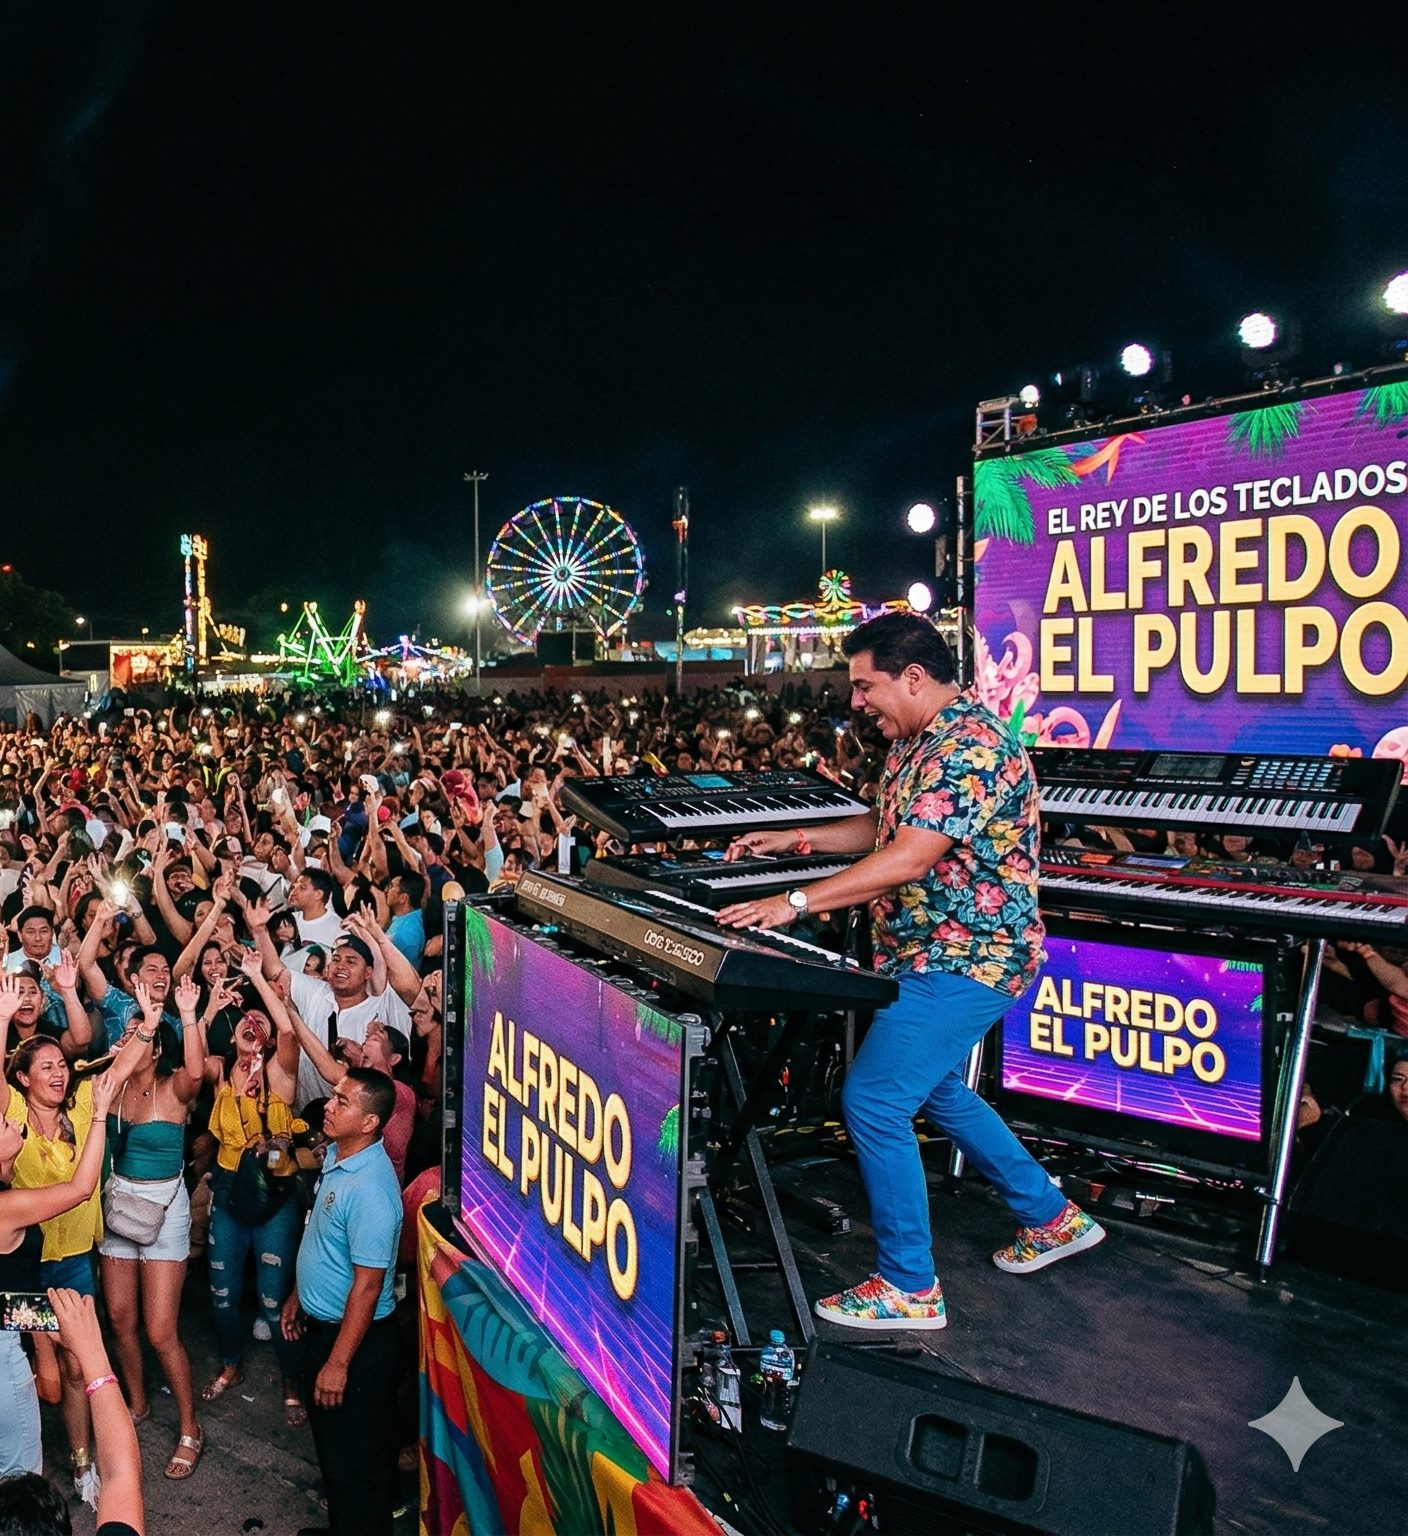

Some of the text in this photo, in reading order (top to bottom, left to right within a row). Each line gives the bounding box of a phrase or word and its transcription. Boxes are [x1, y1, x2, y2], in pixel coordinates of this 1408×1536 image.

[1048, 461, 1407, 535] EL REY DE LOS TECLADOS
[1042, 505, 1400, 614] ALFREDO
[1039, 601, 1408, 695] EL PULPO
[1030, 1012, 1226, 1084] EL PULPO
[1034, 976, 1218, 1039] ALFREDO
[487, 1010, 632, 1190] ALFREDO
[482, 1082, 639, 1302] EL PULPO
